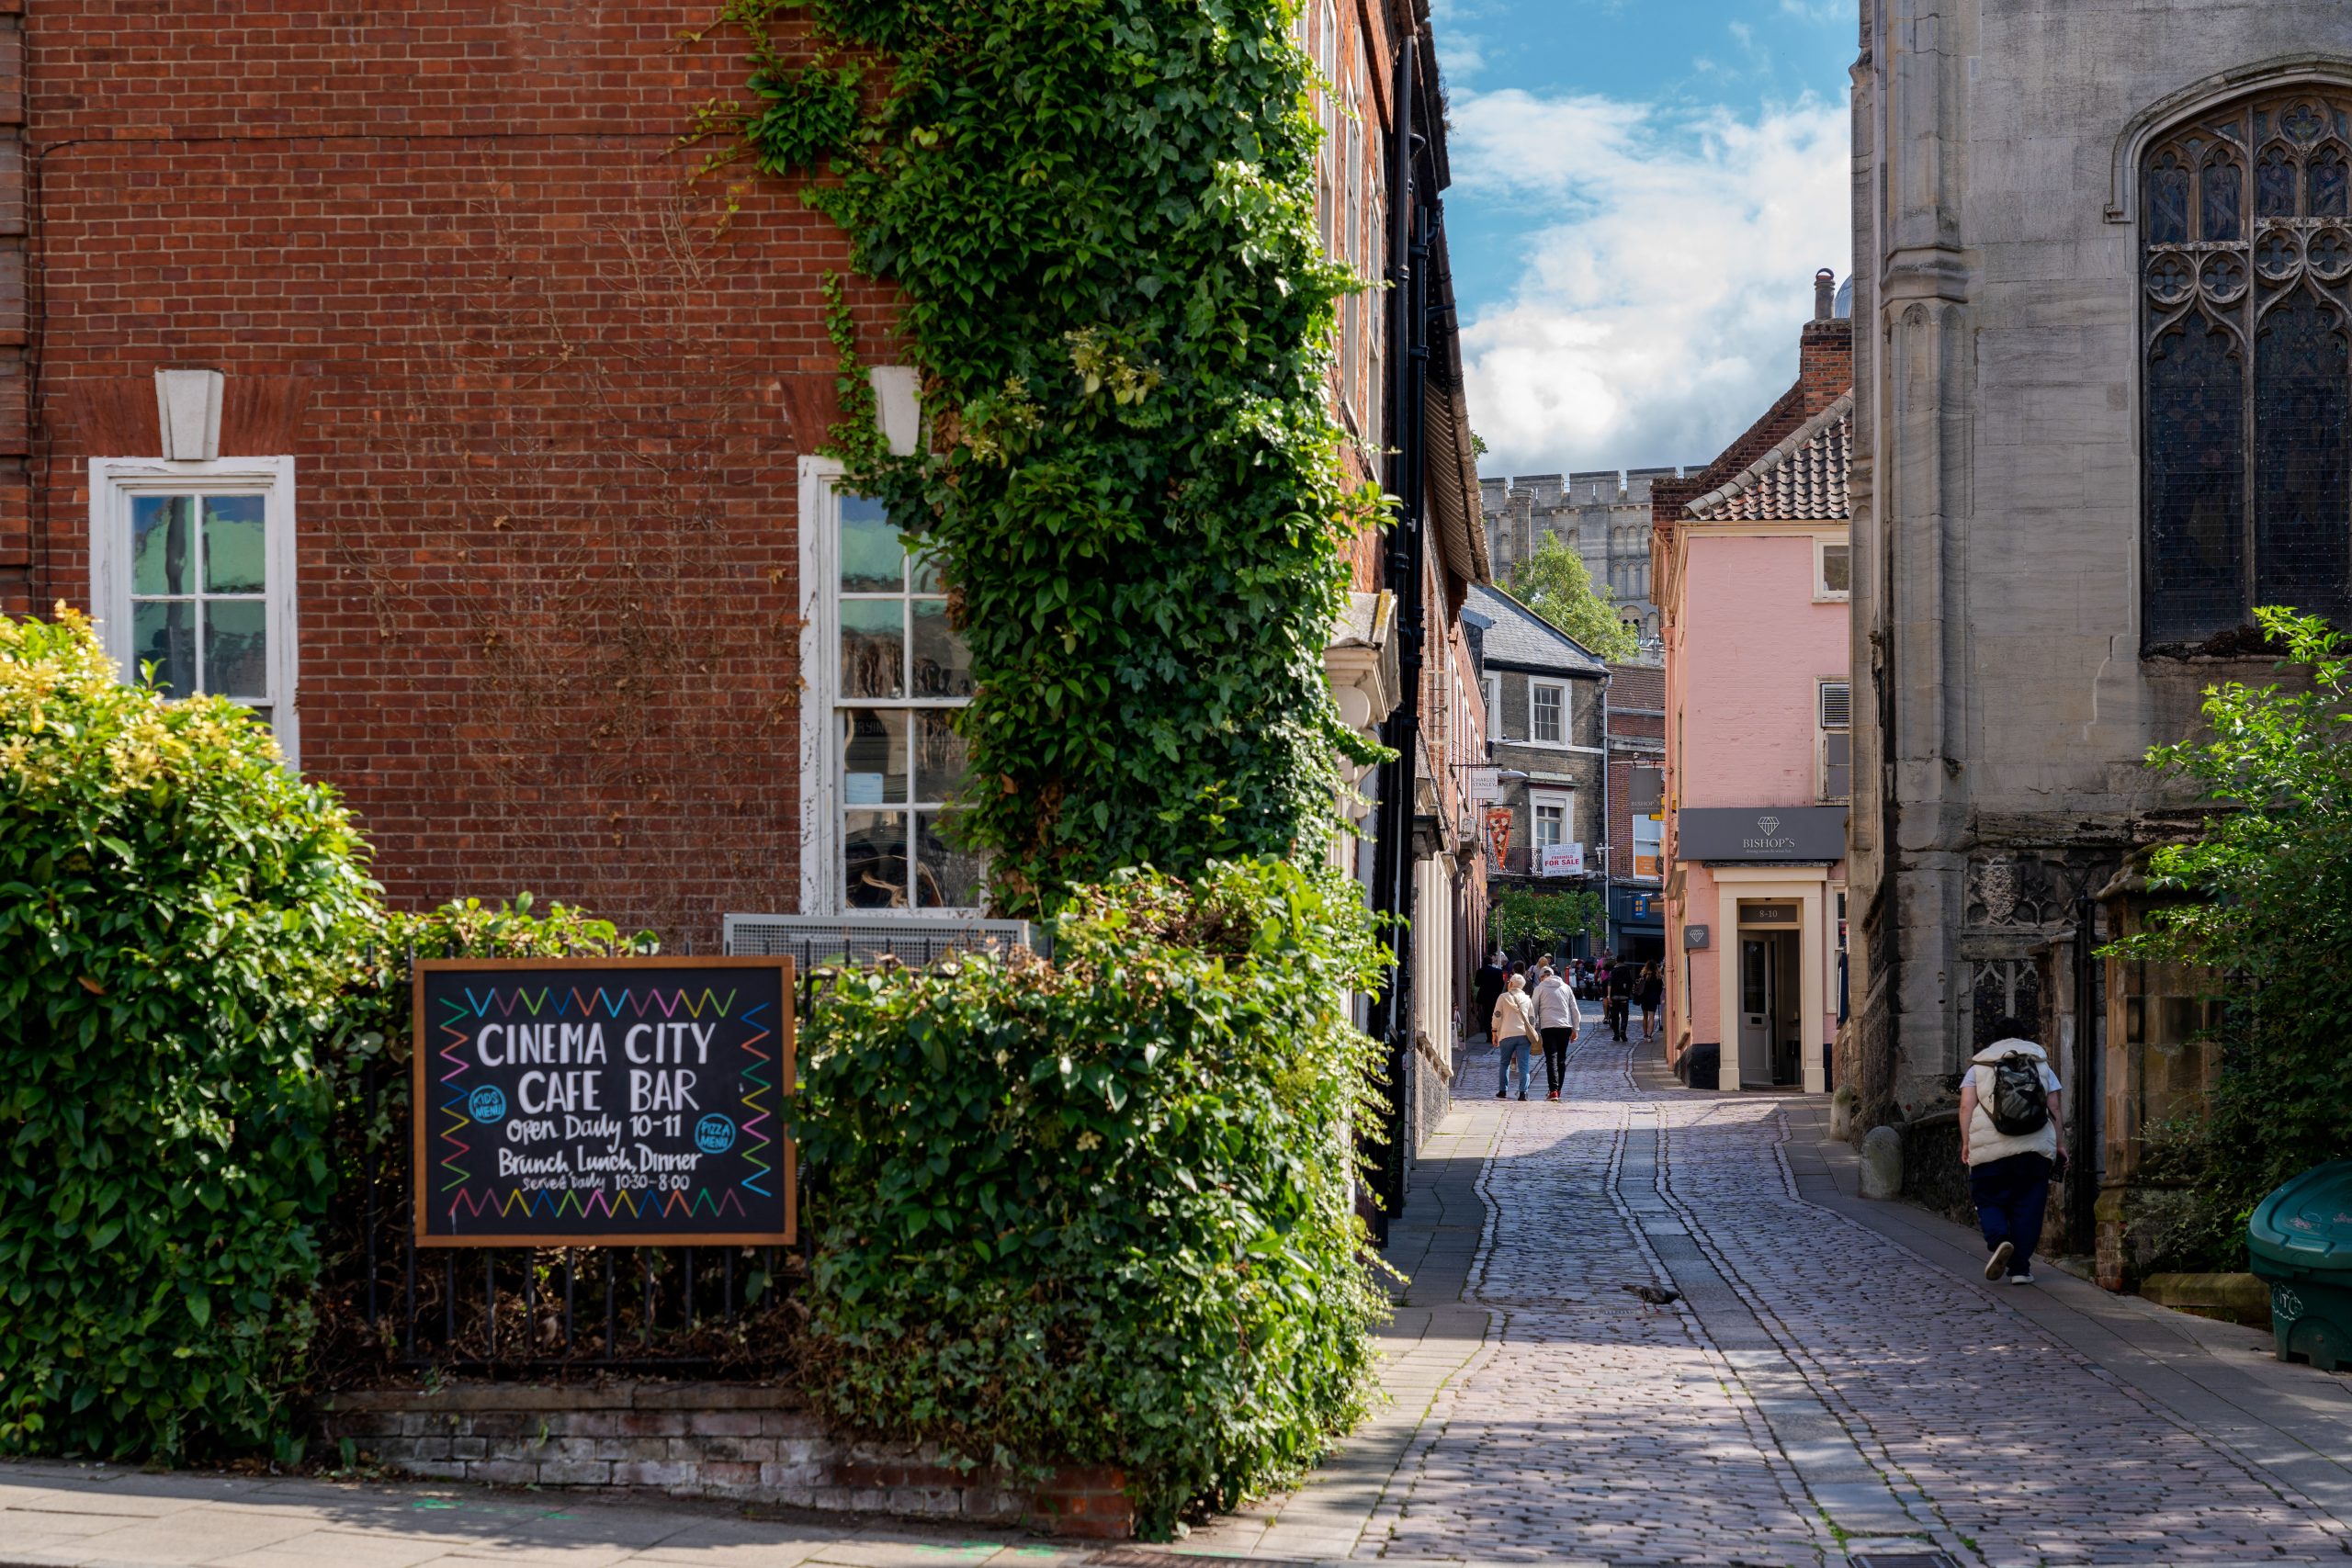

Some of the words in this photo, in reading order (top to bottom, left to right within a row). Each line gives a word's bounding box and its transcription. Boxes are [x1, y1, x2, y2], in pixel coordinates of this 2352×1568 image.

[1743, 837, 1795, 848] BISHOP'S
[1561, 858, 1580, 866] SALE
[1759, 909, 1778, 918] 8-10
[477, 1022, 607, 1066] CINEMA
[625, 1022, 716, 1064] CITY
[473, 1091, 499, 1107] KIDS
[517, 1070, 602, 1114] CAFE
[629, 1069, 700, 1112] BAR
[476, 1103, 502, 1118] MENU
[564, 1113, 622, 1155] Daily
[629, 1114, 682, 1137] 10-11
[701, 1122, 730, 1137] PIZZA
[701, 1135, 729, 1148] MENU
[635, 1143, 703, 1173] Dinner
